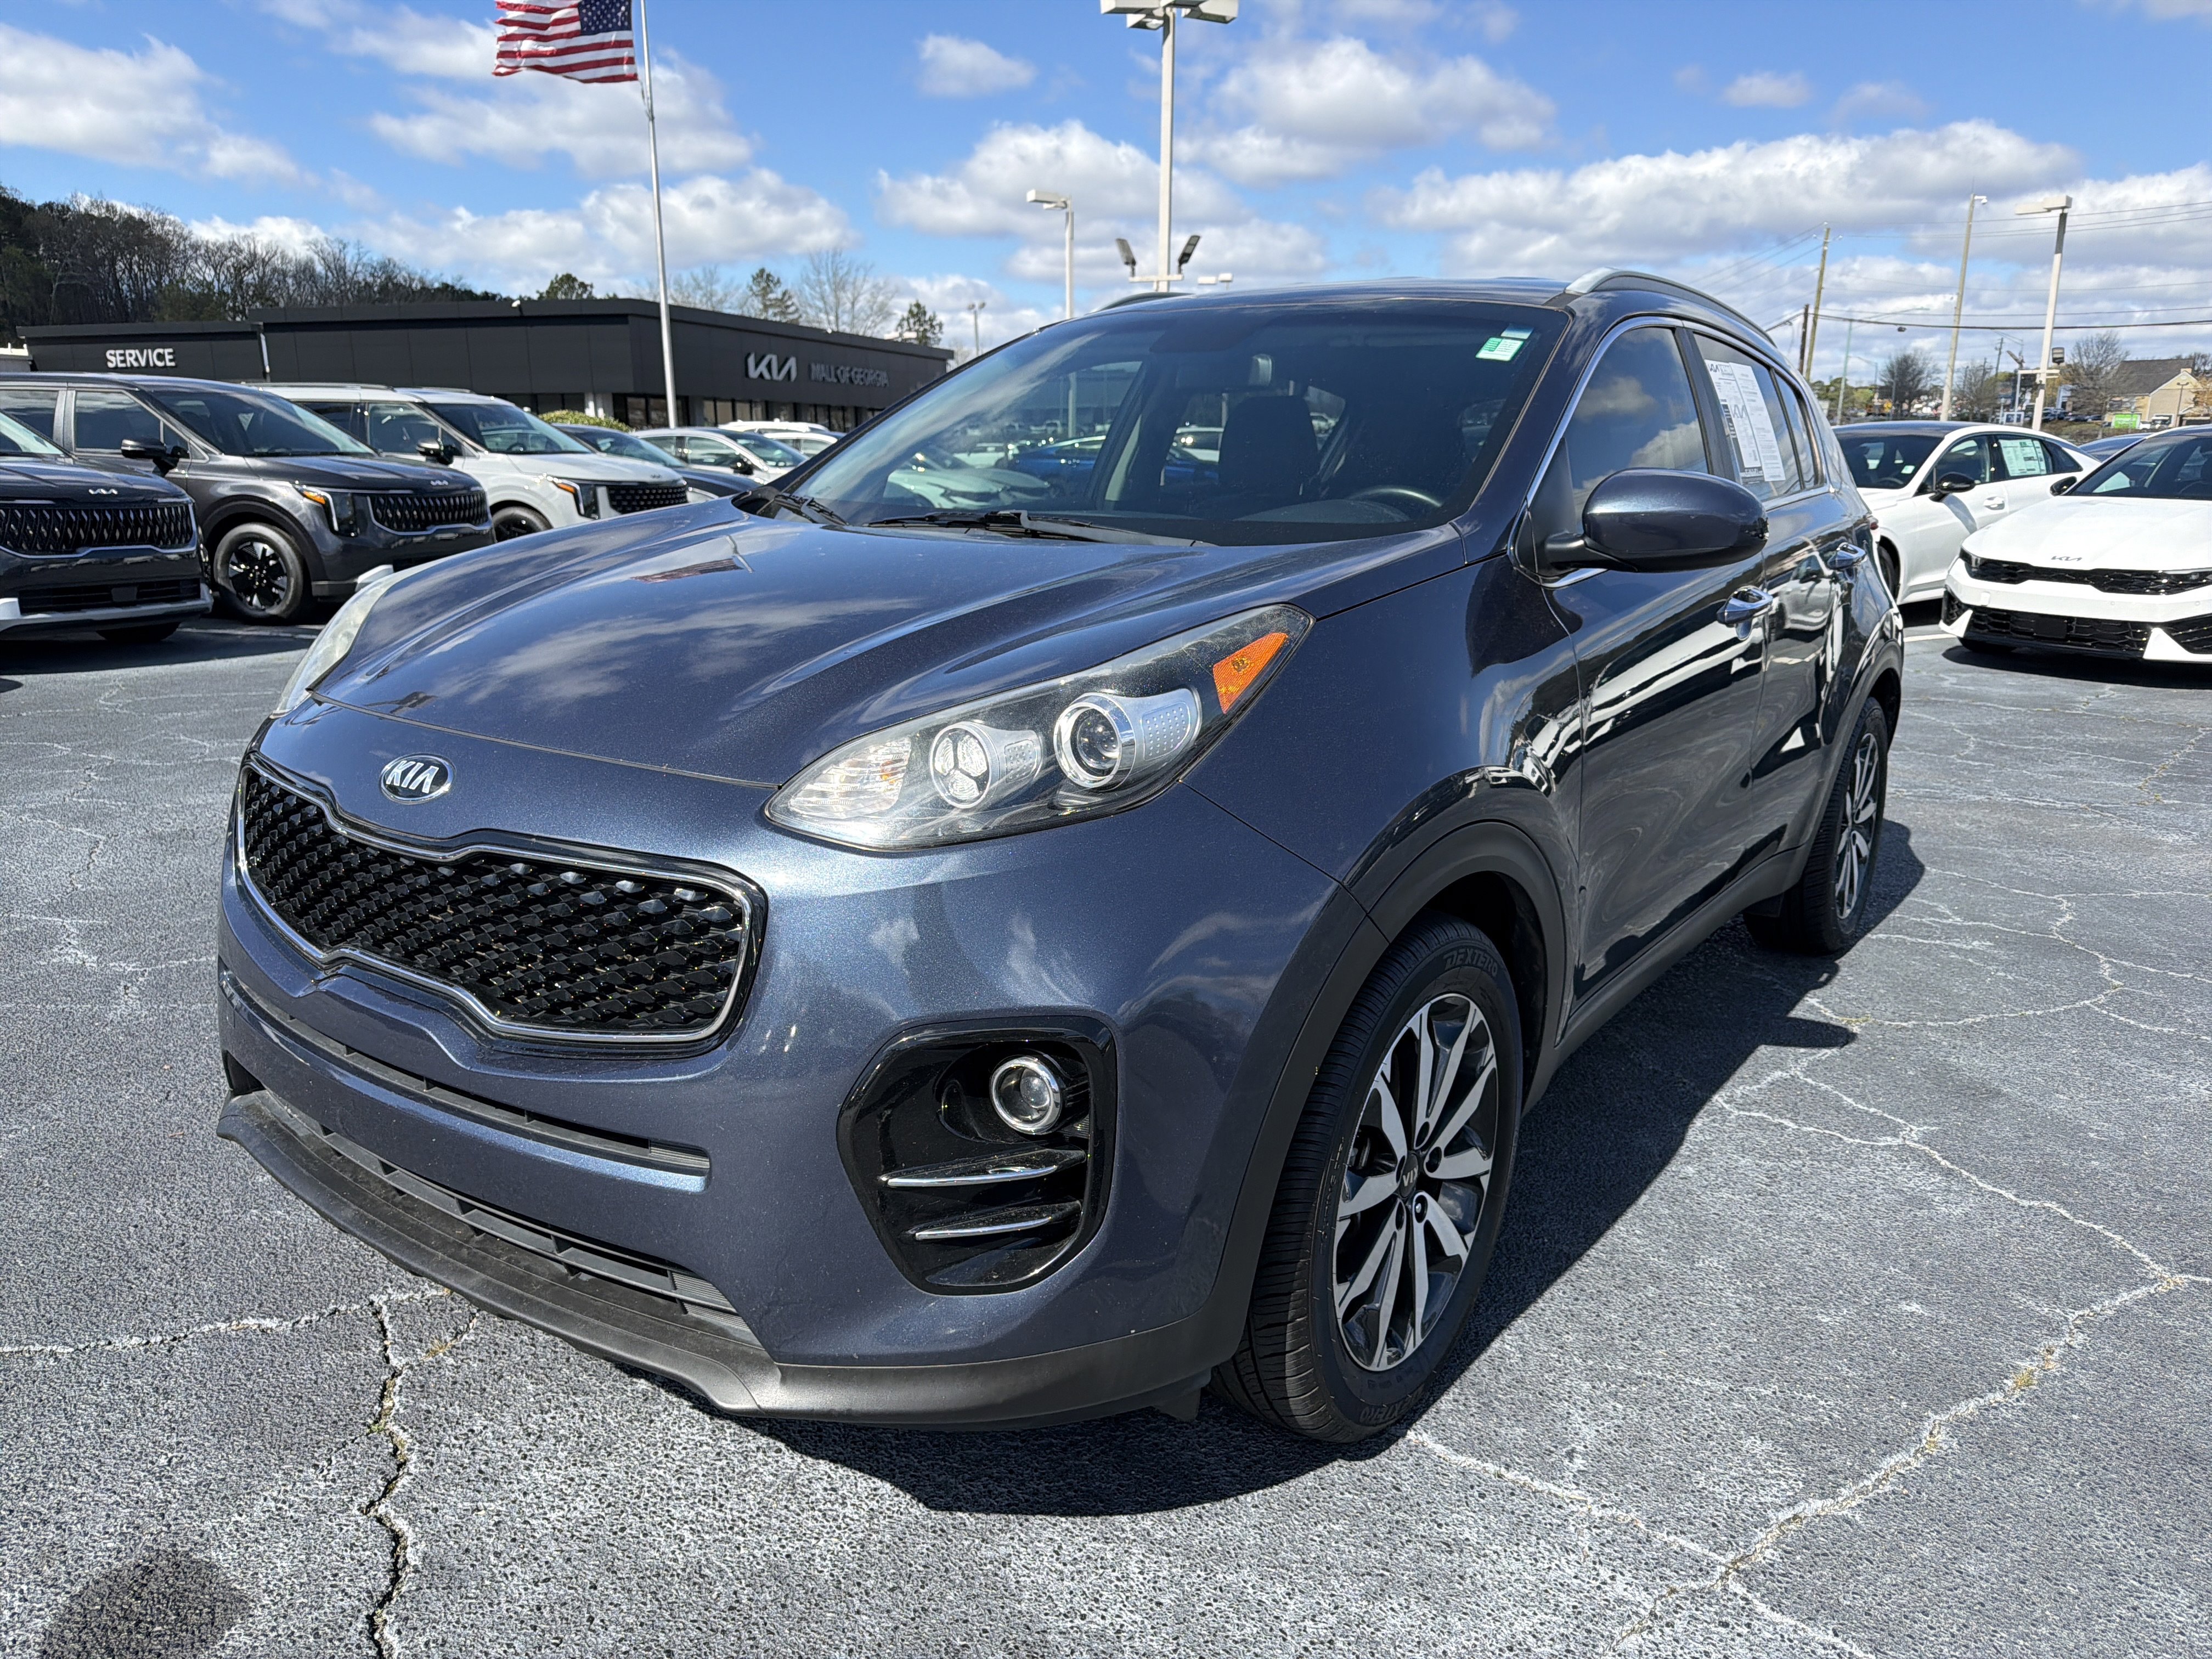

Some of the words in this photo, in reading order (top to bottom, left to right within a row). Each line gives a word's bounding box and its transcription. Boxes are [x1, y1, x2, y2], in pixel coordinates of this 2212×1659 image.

[105, 348, 176, 368] SERVICE
[747, 352, 798, 382] KIA
[810, 363, 837, 382] MALL
[838, 365, 850, 383] OF
[851, 366, 889, 387] GEORGIA
[386, 760, 439, 794] KIA
